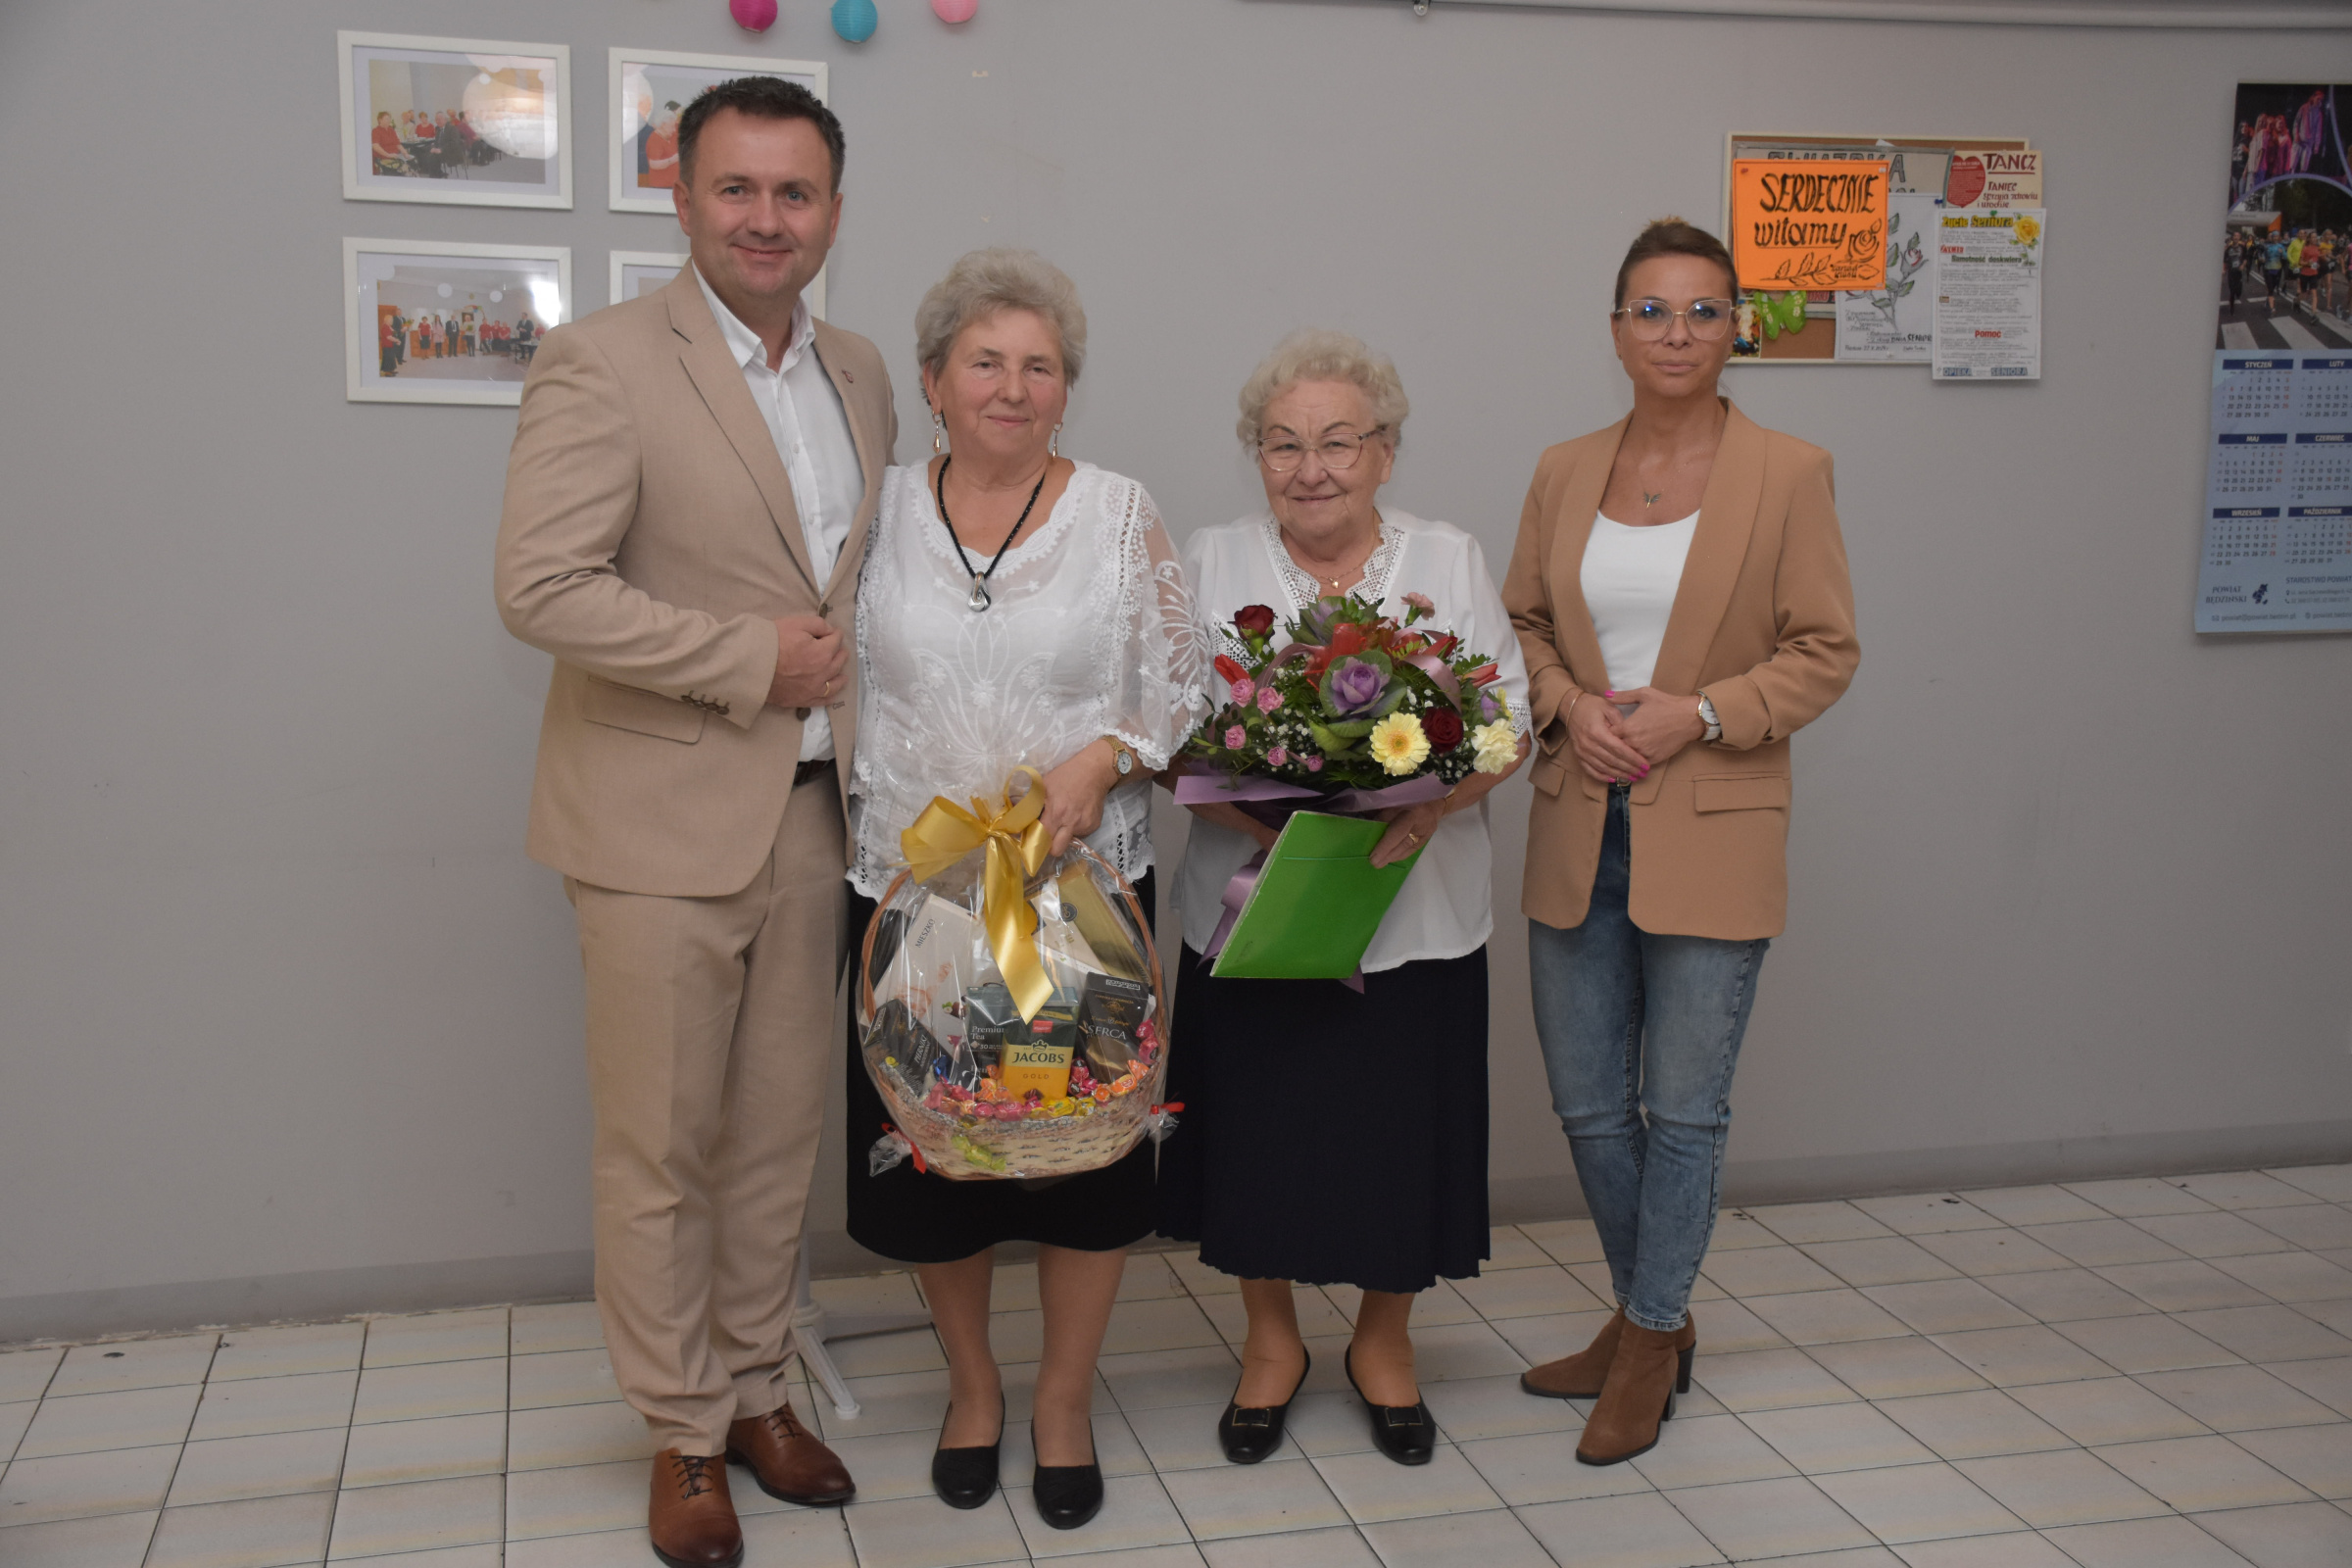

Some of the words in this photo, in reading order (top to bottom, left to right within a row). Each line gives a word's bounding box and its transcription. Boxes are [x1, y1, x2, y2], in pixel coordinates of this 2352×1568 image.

[1760, 172, 1880, 214] SERDECZNIE
[1987, 181, 2018, 192] TANIEC
[1971, 215, 2014, 228] Seniora
[1754, 217, 1847, 250] witamy
[1907, 333, 1932, 342] SENIOR
[1975, 330, 2002, 338] Pomoc
[1943, 367, 1972, 377] OPIEKA
[1990, 367, 2028, 377] SENIORA
[915, 918, 936, 948] MIESZKO
[1088, 1025, 1127, 1040] SERCA
[914, 1034, 929, 1063] PIERNIKI
[1012, 1052, 1065, 1064] JACOBS
